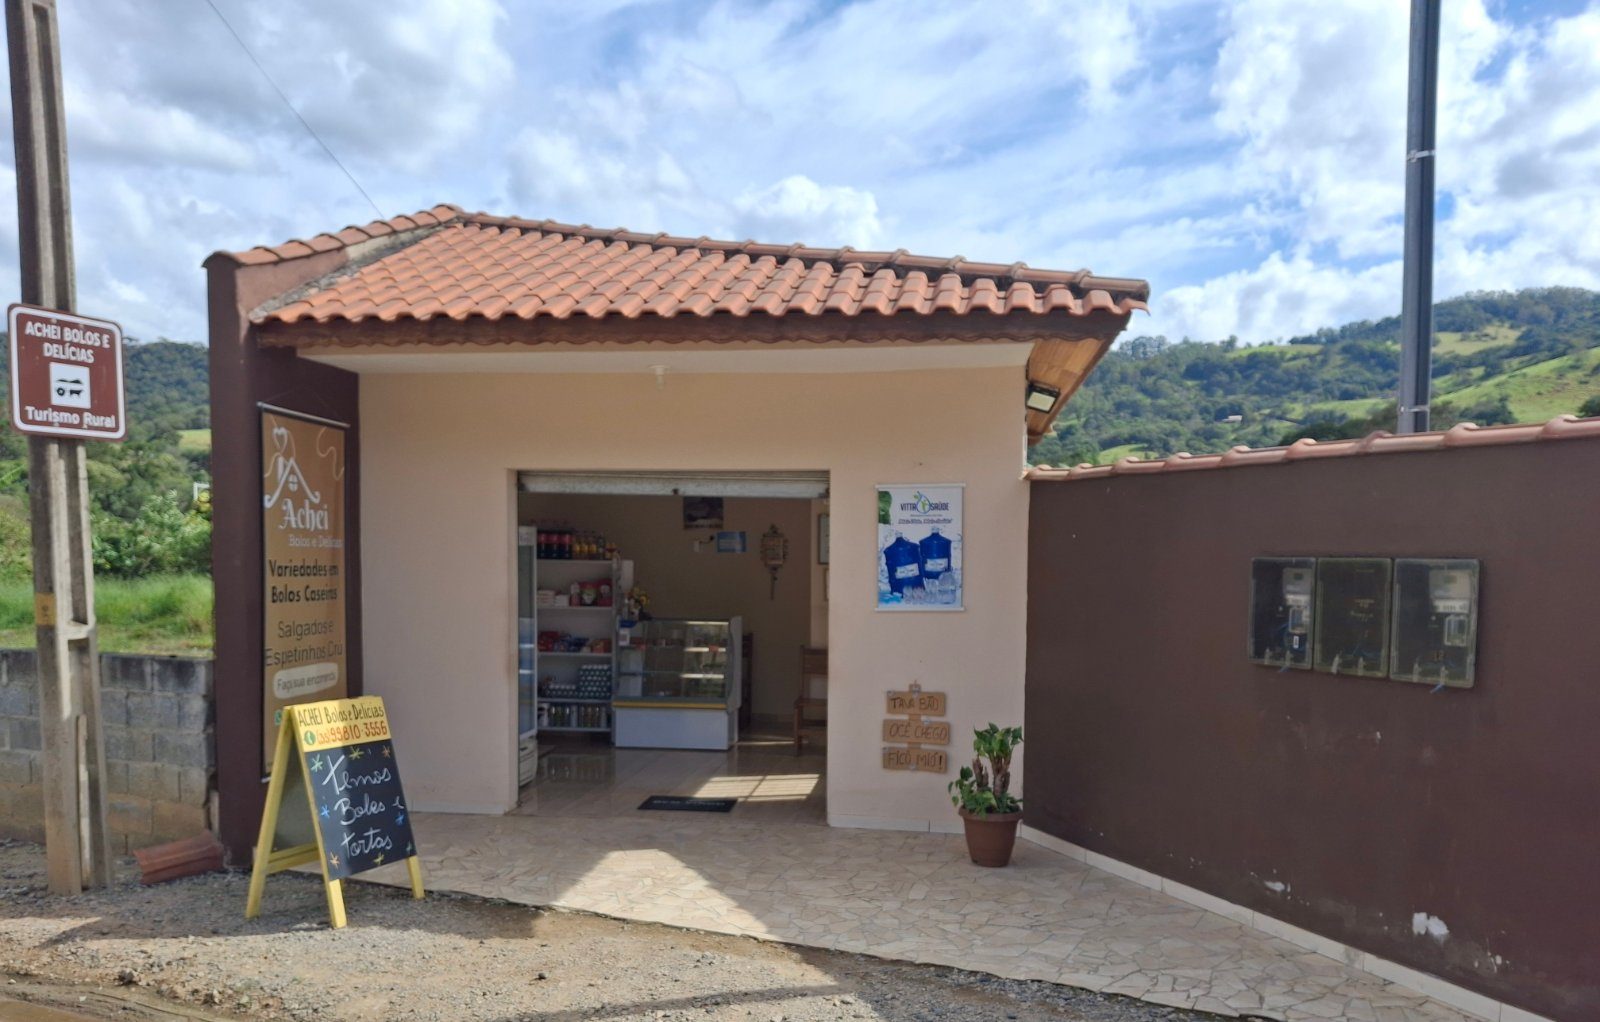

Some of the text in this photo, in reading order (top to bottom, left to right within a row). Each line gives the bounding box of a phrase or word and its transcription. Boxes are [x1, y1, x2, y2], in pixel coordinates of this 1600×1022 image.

[25, 321, 111, 348] ACHEI BOLOS E
[43, 342, 95, 363] DELÍCIAS
[25, 405, 115, 428] Turismo Rural
[279, 498, 329, 532] Achei
[268, 559, 327, 577] Variedades
[271, 584, 302, 603] Bolos
[278, 619, 327, 641] Salgados
[266, 643, 326, 668] Espetinhos
[298, 707, 323, 727] ACHEI
[322, 754, 392, 795] Temos
